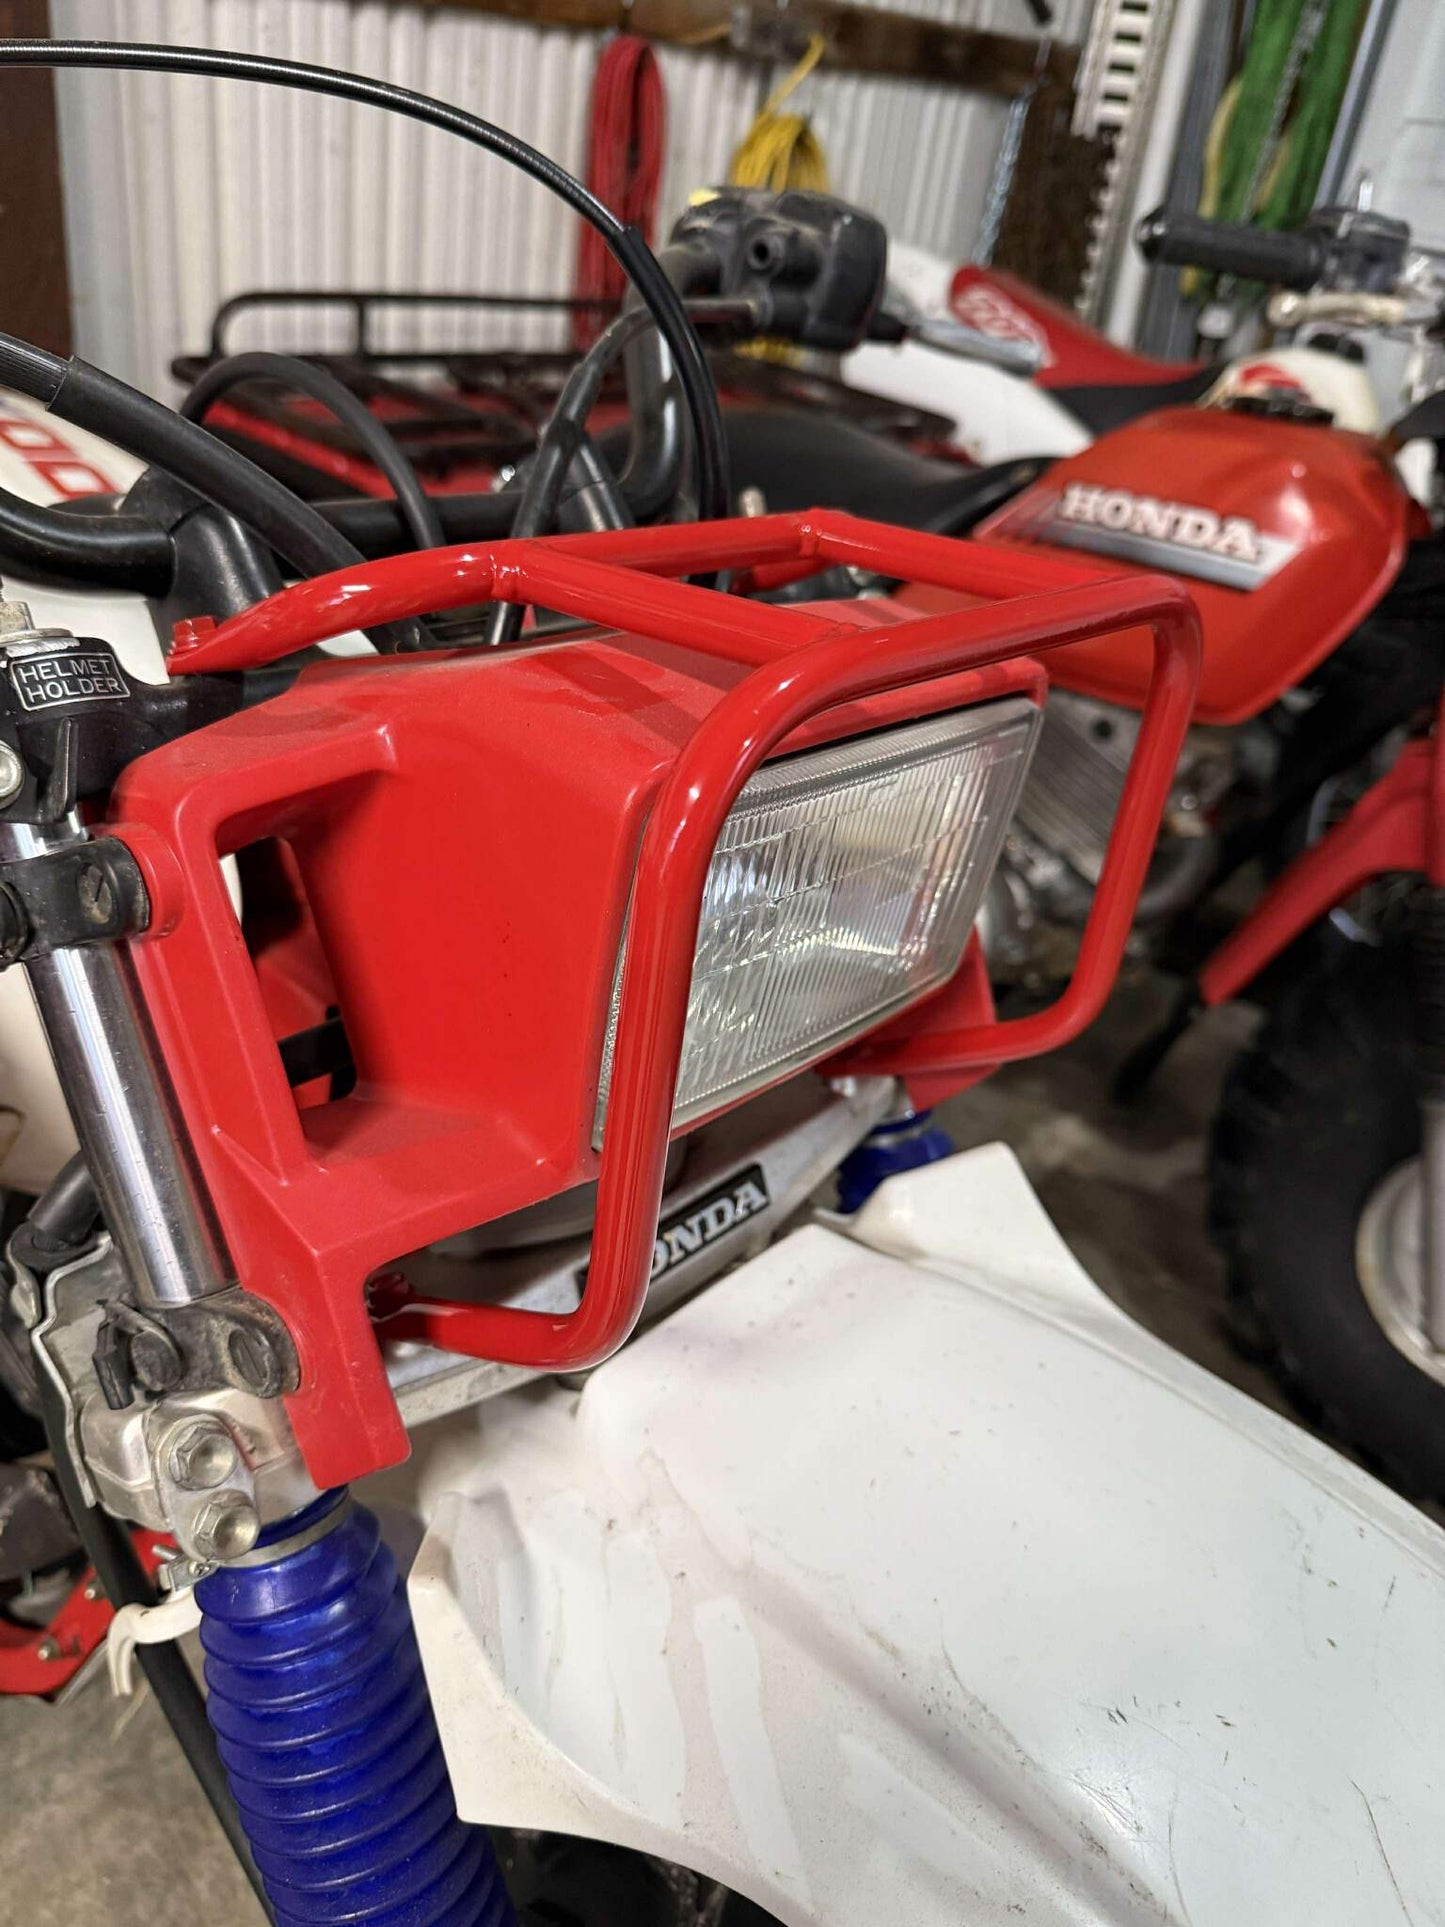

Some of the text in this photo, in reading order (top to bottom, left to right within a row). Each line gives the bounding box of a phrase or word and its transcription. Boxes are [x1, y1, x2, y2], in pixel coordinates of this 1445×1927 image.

[1061, 483, 1258, 562] HONDA
[18, 659, 111, 683] HELMET
[26, 678, 122, 703] HOLDER
[650, 1181, 768, 1279] ONDA
